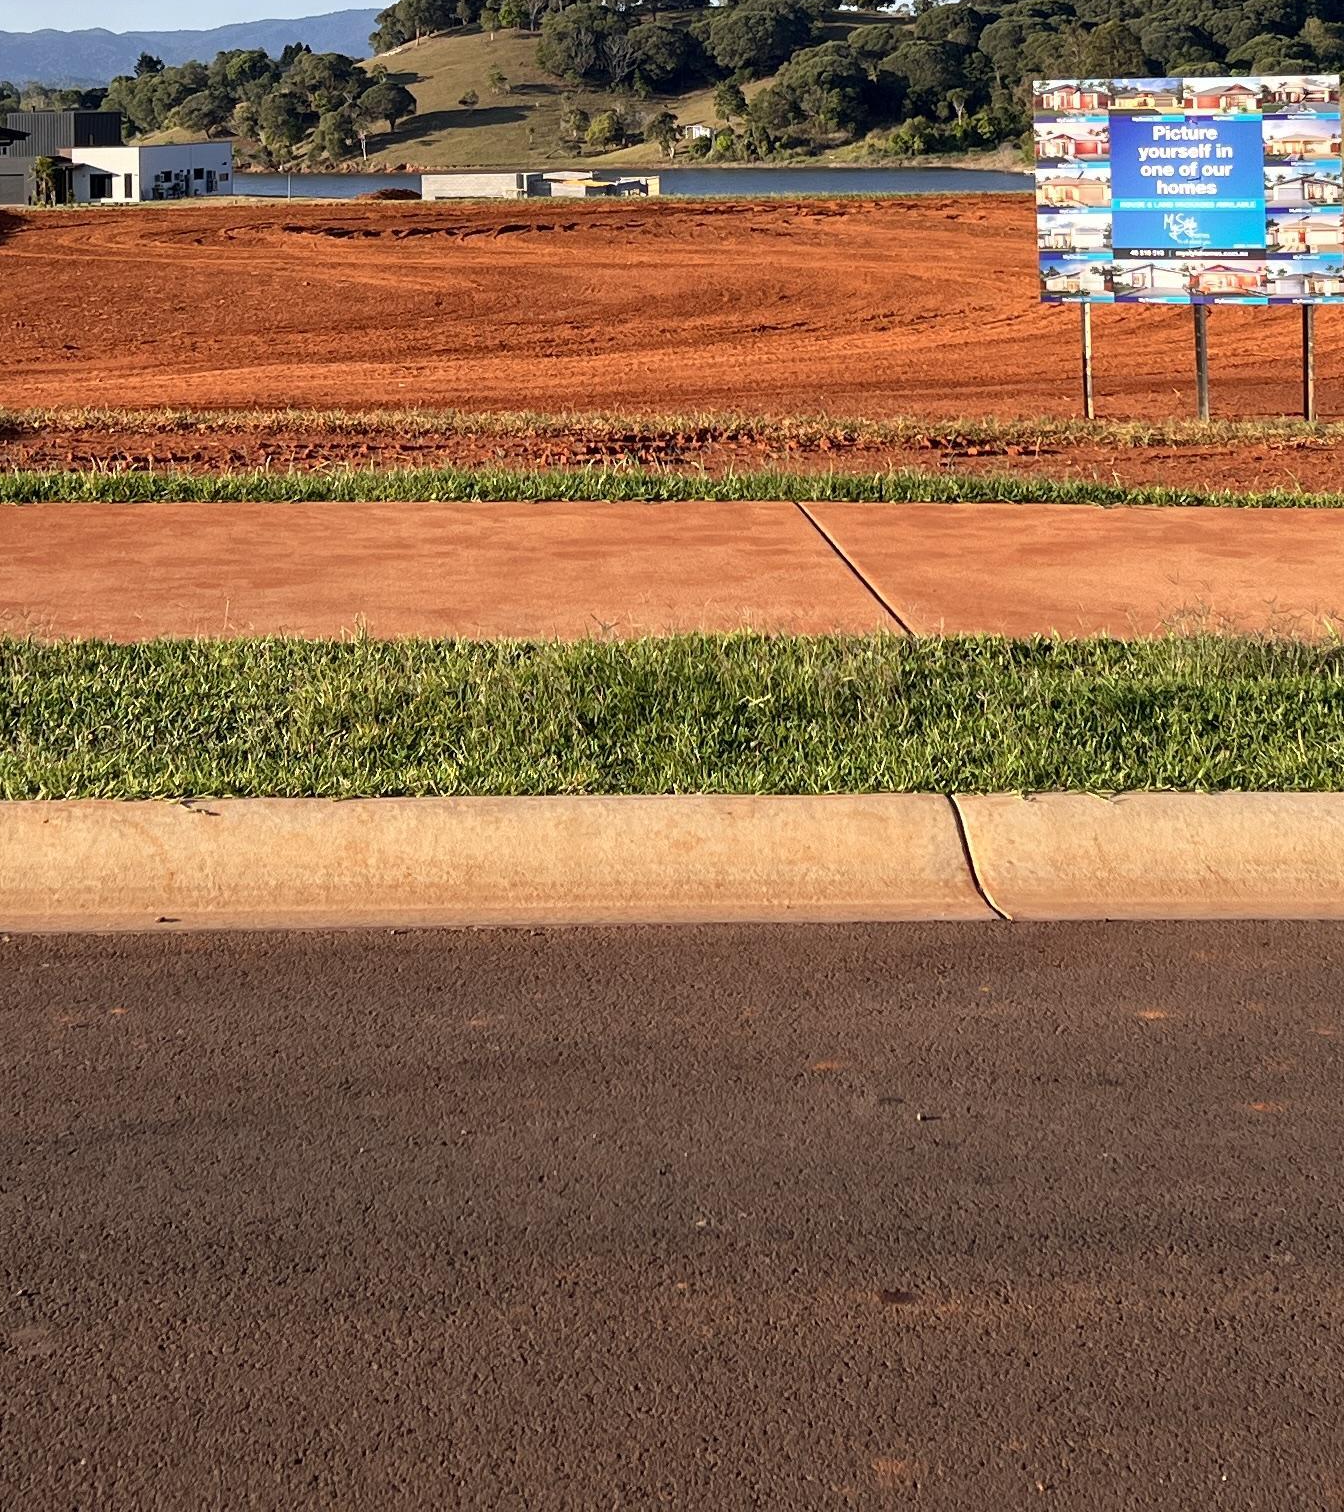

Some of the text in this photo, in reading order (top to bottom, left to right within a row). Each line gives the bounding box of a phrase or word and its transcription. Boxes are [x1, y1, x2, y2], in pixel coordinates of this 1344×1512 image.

[1152, 125, 1218, 141] Picture
[1137, 143, 1233, 161] yourself in
[1140, 162, 1233, 177] one of our
[1156, 179, 1218, 195] homes
